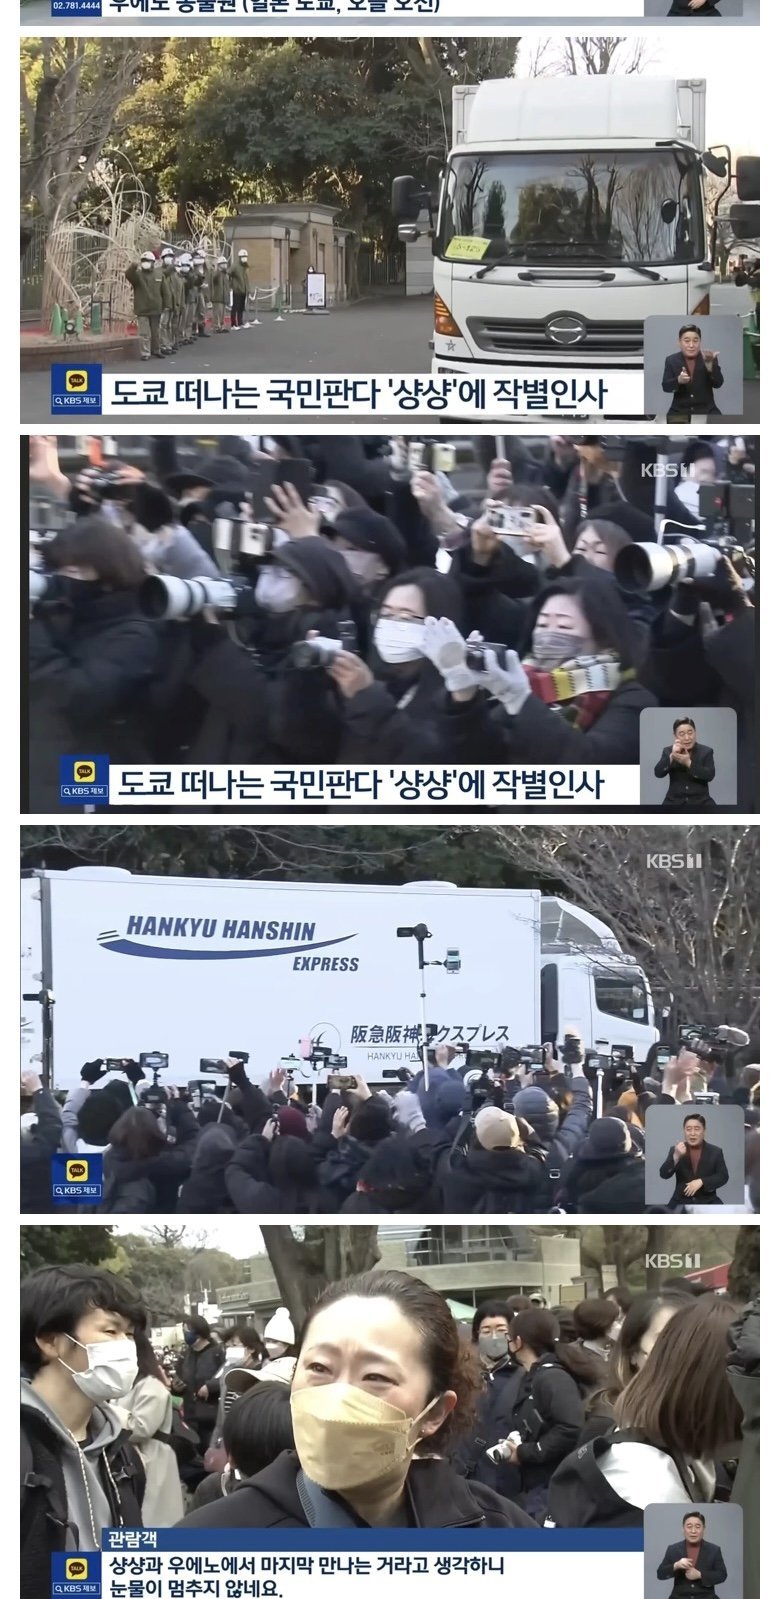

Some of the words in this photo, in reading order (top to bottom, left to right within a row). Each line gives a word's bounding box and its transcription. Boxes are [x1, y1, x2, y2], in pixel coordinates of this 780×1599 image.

[126, 915, 217, 938] HANKYU
[222, 919, 316, 941] HANSHIN
[293, 956, 359, 972] EXPRESS
[350, 1024, 510, 1044] 阪急阪神クスプレス
[367, 1052, 403, 1061] HANKYU
